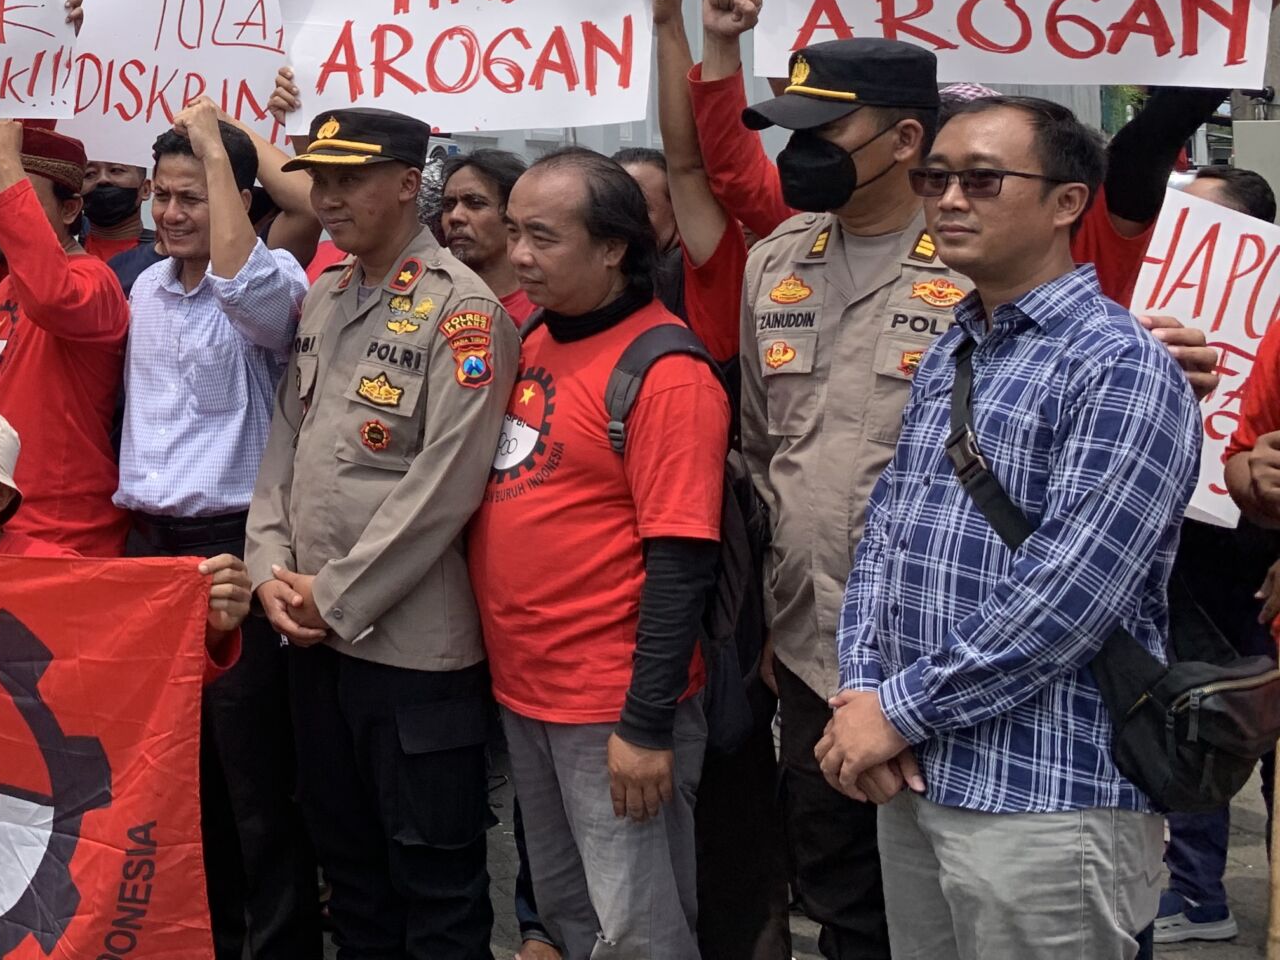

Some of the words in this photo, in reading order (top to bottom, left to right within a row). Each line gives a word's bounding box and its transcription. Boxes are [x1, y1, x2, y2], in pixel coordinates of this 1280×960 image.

[315, 14, 633, 102] AROGAN
[444, 314, 487, 331] POLRES
[759, 312, 816, 330] ZAINUDDIN
[367, 342, 421, 370] POLRI
[505, 412, 527, 429] SPBI
[526, 441, 566, 491] INDONESIA
